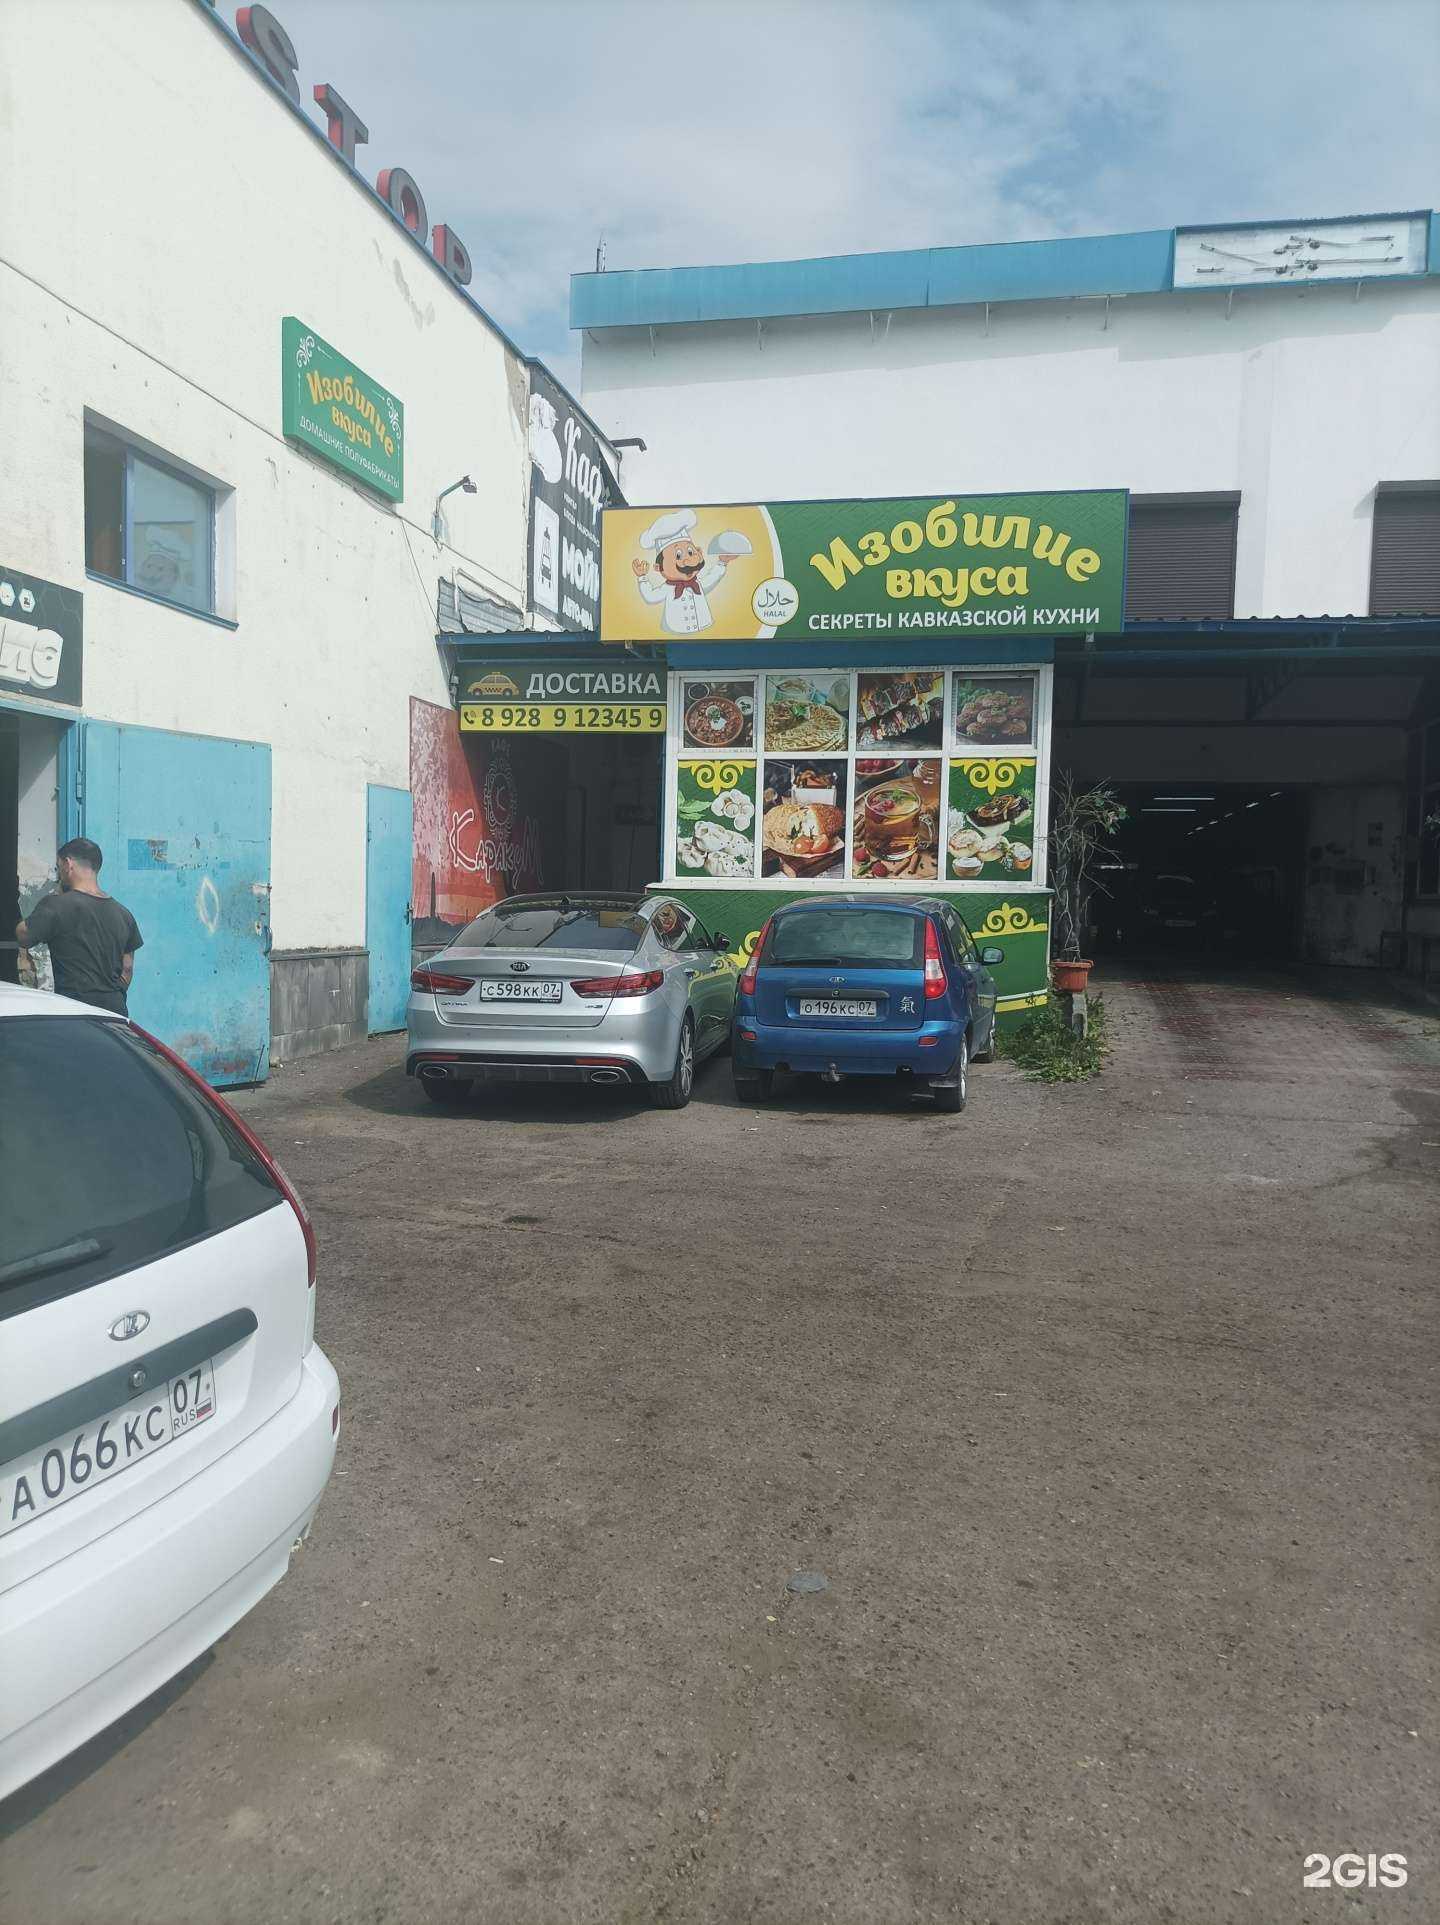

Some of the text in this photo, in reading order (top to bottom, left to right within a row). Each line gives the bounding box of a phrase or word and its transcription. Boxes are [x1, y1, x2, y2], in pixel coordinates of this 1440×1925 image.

[306, 369, 394, 458] Изобилие
[331, 405, 372, 448] вкуса
[299, 415, 400, 489] ДОМАШНИЕ ПОЛУФАБРИКАТЫ
[809, 500, 1101, 591] Изобилие
[757, 588, 794, 608] حلال
[885, 566, 1030, 608] вкуса
[763, 610, 787, 618] HALAL
[808, 605, 1100, 630] СЕКРЕТЫ КАВКАЗСКОЙ КУХНИ
[526, 673, 661, 698] ДОСТАВКА
[481, 708, 662, 727] 8 928 9 12345 9
[543, 983, 556, 994] 07
[858, 1001, 872, 1011] 07
[173, 1369, 202, 1414] 07
[173, 1408, 197, 1431] RUS
